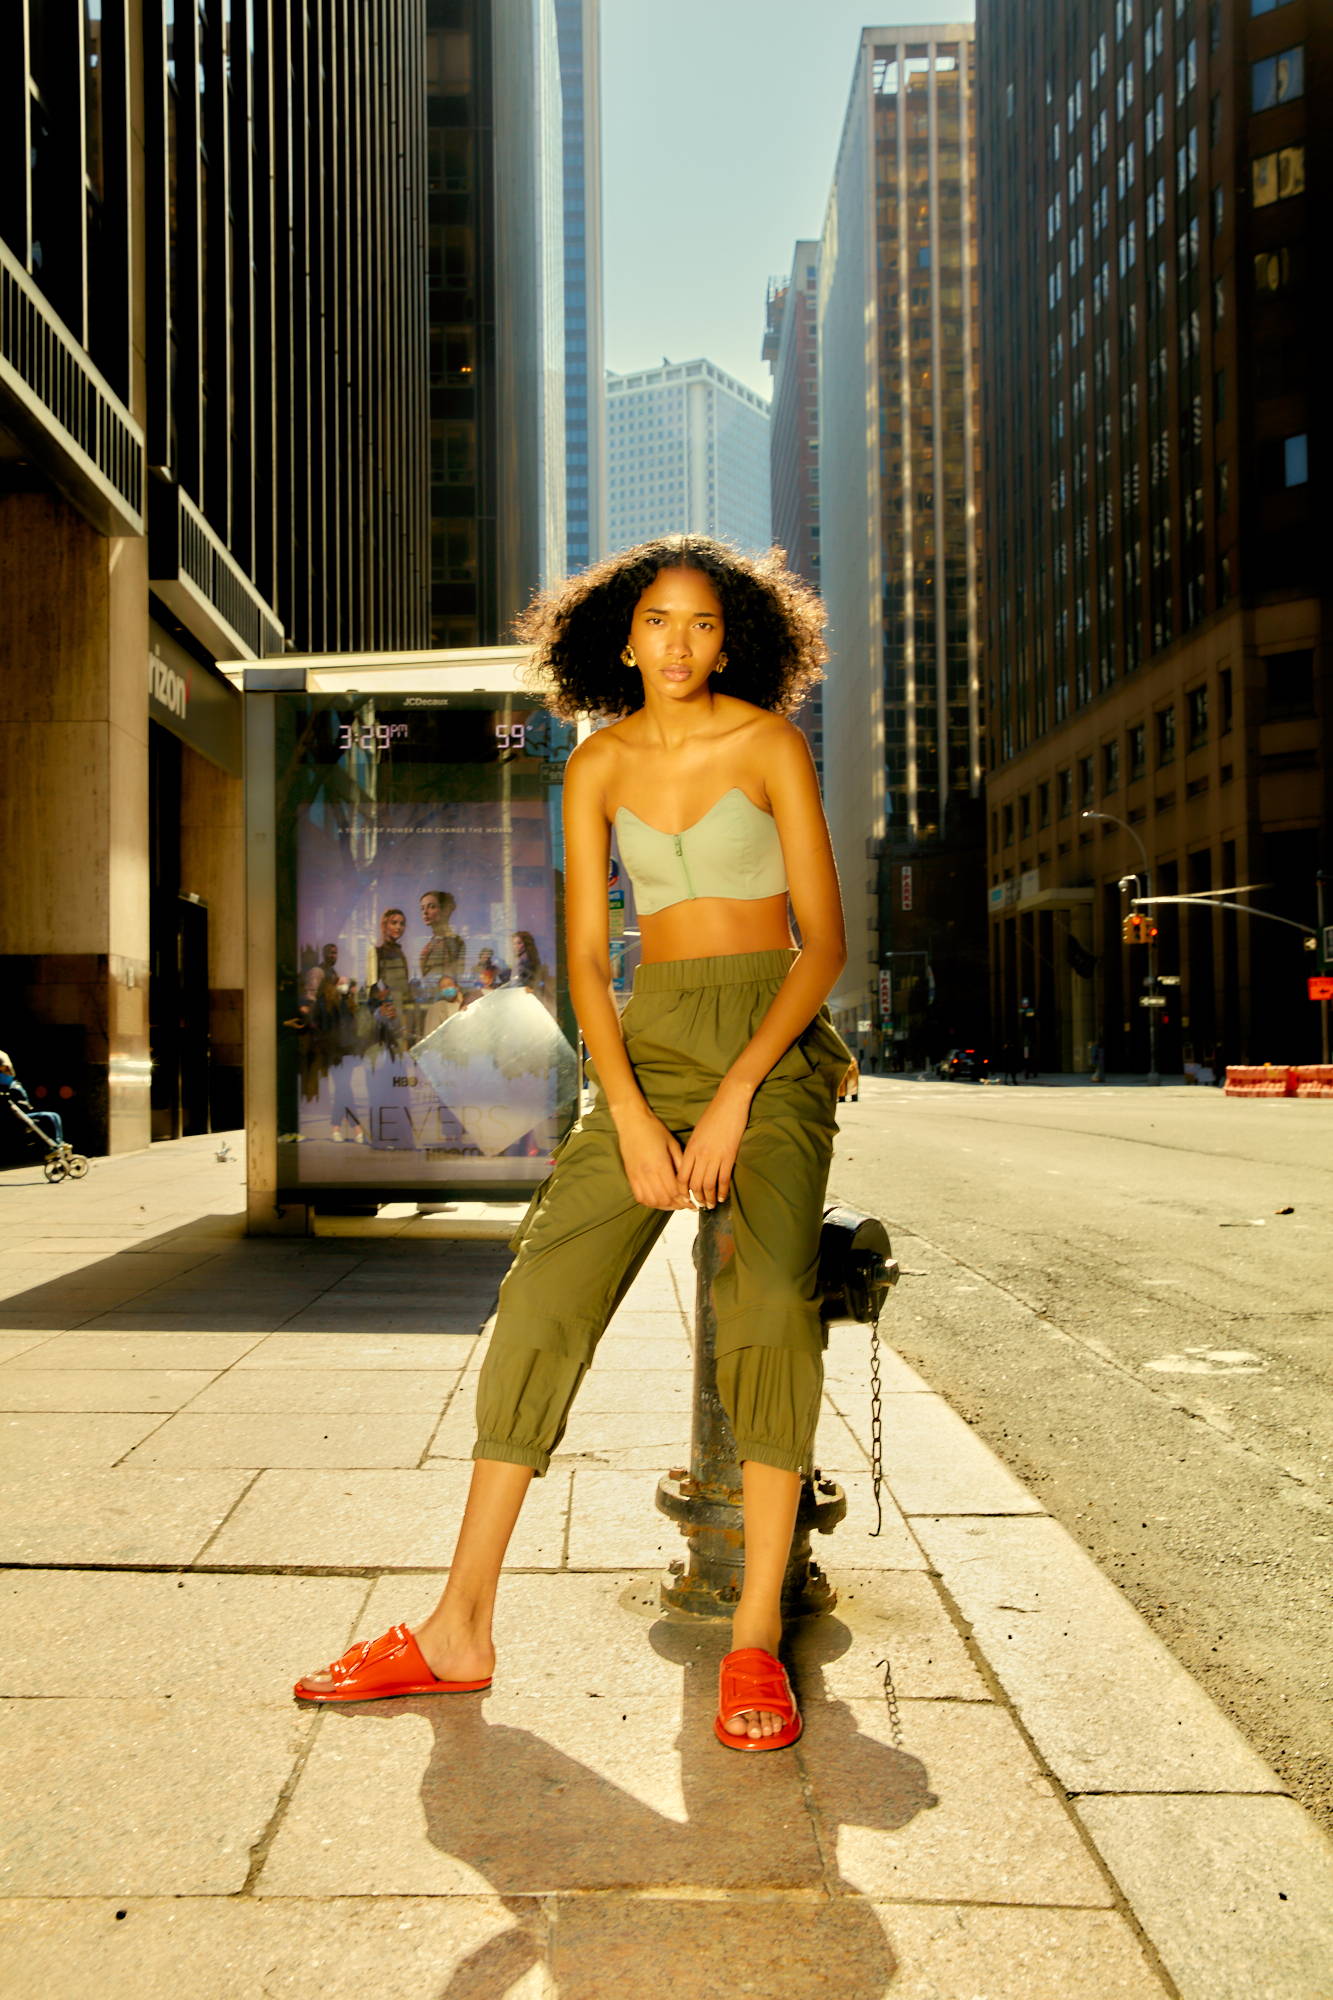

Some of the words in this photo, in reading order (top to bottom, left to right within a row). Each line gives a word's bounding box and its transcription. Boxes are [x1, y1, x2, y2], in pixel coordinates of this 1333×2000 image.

[403, 697, 448, 706] JCDecaux
[903, 873, 911, 902] PARK
[880, 977, 889, 1005] PARK
[392, 1076, 418, 1087] HBO
[344, 1106, 511, 1142] NEVERS
